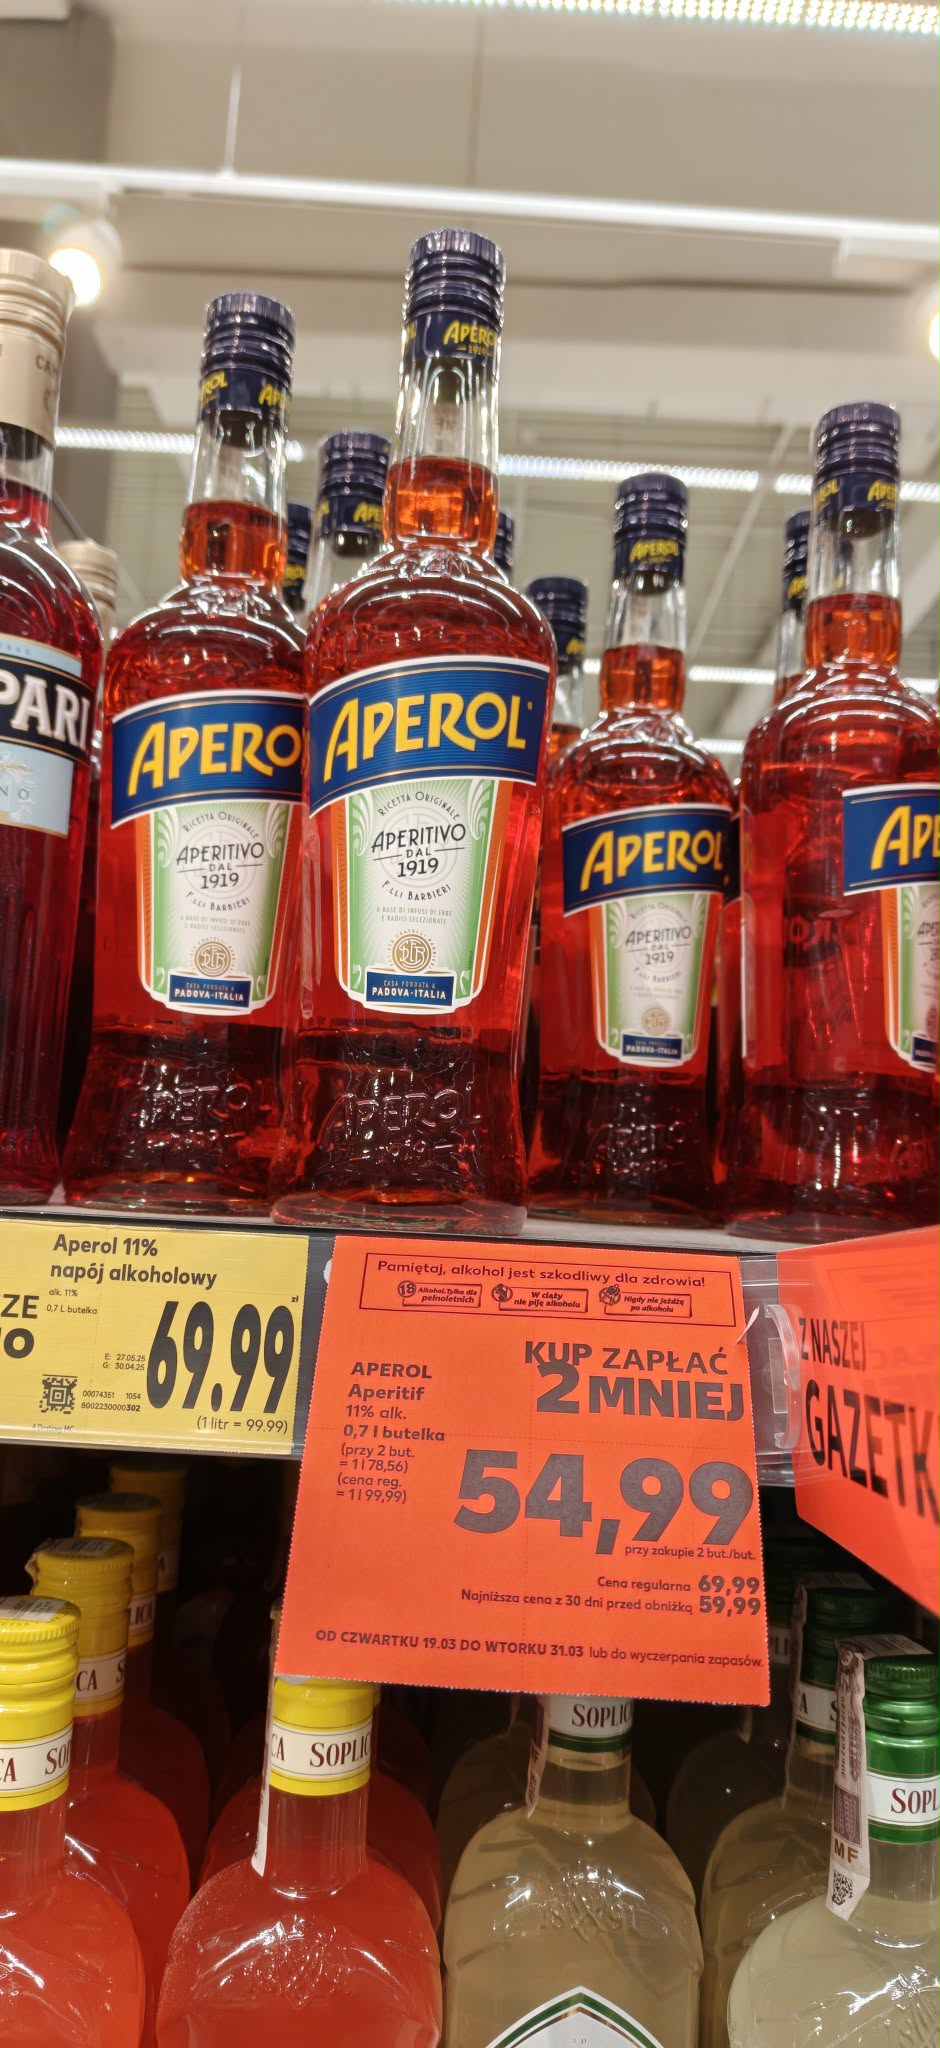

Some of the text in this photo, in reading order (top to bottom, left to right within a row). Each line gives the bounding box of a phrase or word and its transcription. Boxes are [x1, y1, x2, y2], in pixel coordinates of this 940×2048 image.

[378, 791, 460, 820] RICETTA ORIGINALE
[183, 811, 214, 833] RICETTA
[371, 823, 466, 853] APERITIVO
[176, 842, 265, 865] APERITIVO
[406, 849, 431, 857] DAL
[397, 857, 439, 878] 1919
[200, 872, 239, 889] 1919
[408, 884, 451, 901] BARBIERI
[210, 897, 250, 911] BARBIERI
[625, 926, 691, 946] APERITIVO
[645, 951, 674, 965] 1919
[53, 1234, 158, 1256] Aperol 11%
[51, 1262, 217, 1290] napój alkoholowy
[378, 1261, 705, 1287] Pamiętaj, alkohol jest szkodliwy dla zdrowia!
[65, 1289, 78, 1297] 11%
[624, 1295, 645, 1305] Nigdy
[0, 1293, 39, 1319] ZE
[47, 1305, 58, 1314] 0,7
[67, 1306, 97, 1315] butelka
[642, 1305, 674, 1313] alkoholu
[810, 1318, 867, 1372] NASZEJ
[116, 1354, 146, 1362] 27.05.25
[146, 1300, 295, 1414] 69.99
[524, 1340, 728, 1375] KUP ZAPŁAĆ
[351, 1361, 432, 1379] APEROL
[83, 1390, 141, 1400] 00074351 1054
[348, 1383, 424, 1401] Aperitif
[537, 1360, 744, 1422] 2 MNIEJ
[346, 1405, 407, 1419] 11% alk.
[211, 1417, 229, 1430] litr
[246, 1419, 288, 1435] 99.99)
[343, 1425, 368, 1439] 0,7
[383, 1426, 445, 1442] butelka
[341, 1443, 415, 1458] (przy 2 but.
[368, 1460, 408, 1474] 78,56)
[337, 1472, 402, 1490] (cena reg.
[367, 1490, 407, 1504] 99,99)
[453, 1449, 754, 1555] 54,99
[625, 1545, 756, 1561] przy zakupie 2 but./but.
[597, 1575, 760, 1596] Cena regularna 69,99
[461, 1588, 761, 1617] Najniższa cena z 30 dni przed obniżką 59,99
[316, 1629, 764, 1669] OD CZWARTKU 19.03 DO WTORKU 31.03 lub do wyczerpania zapasów.
